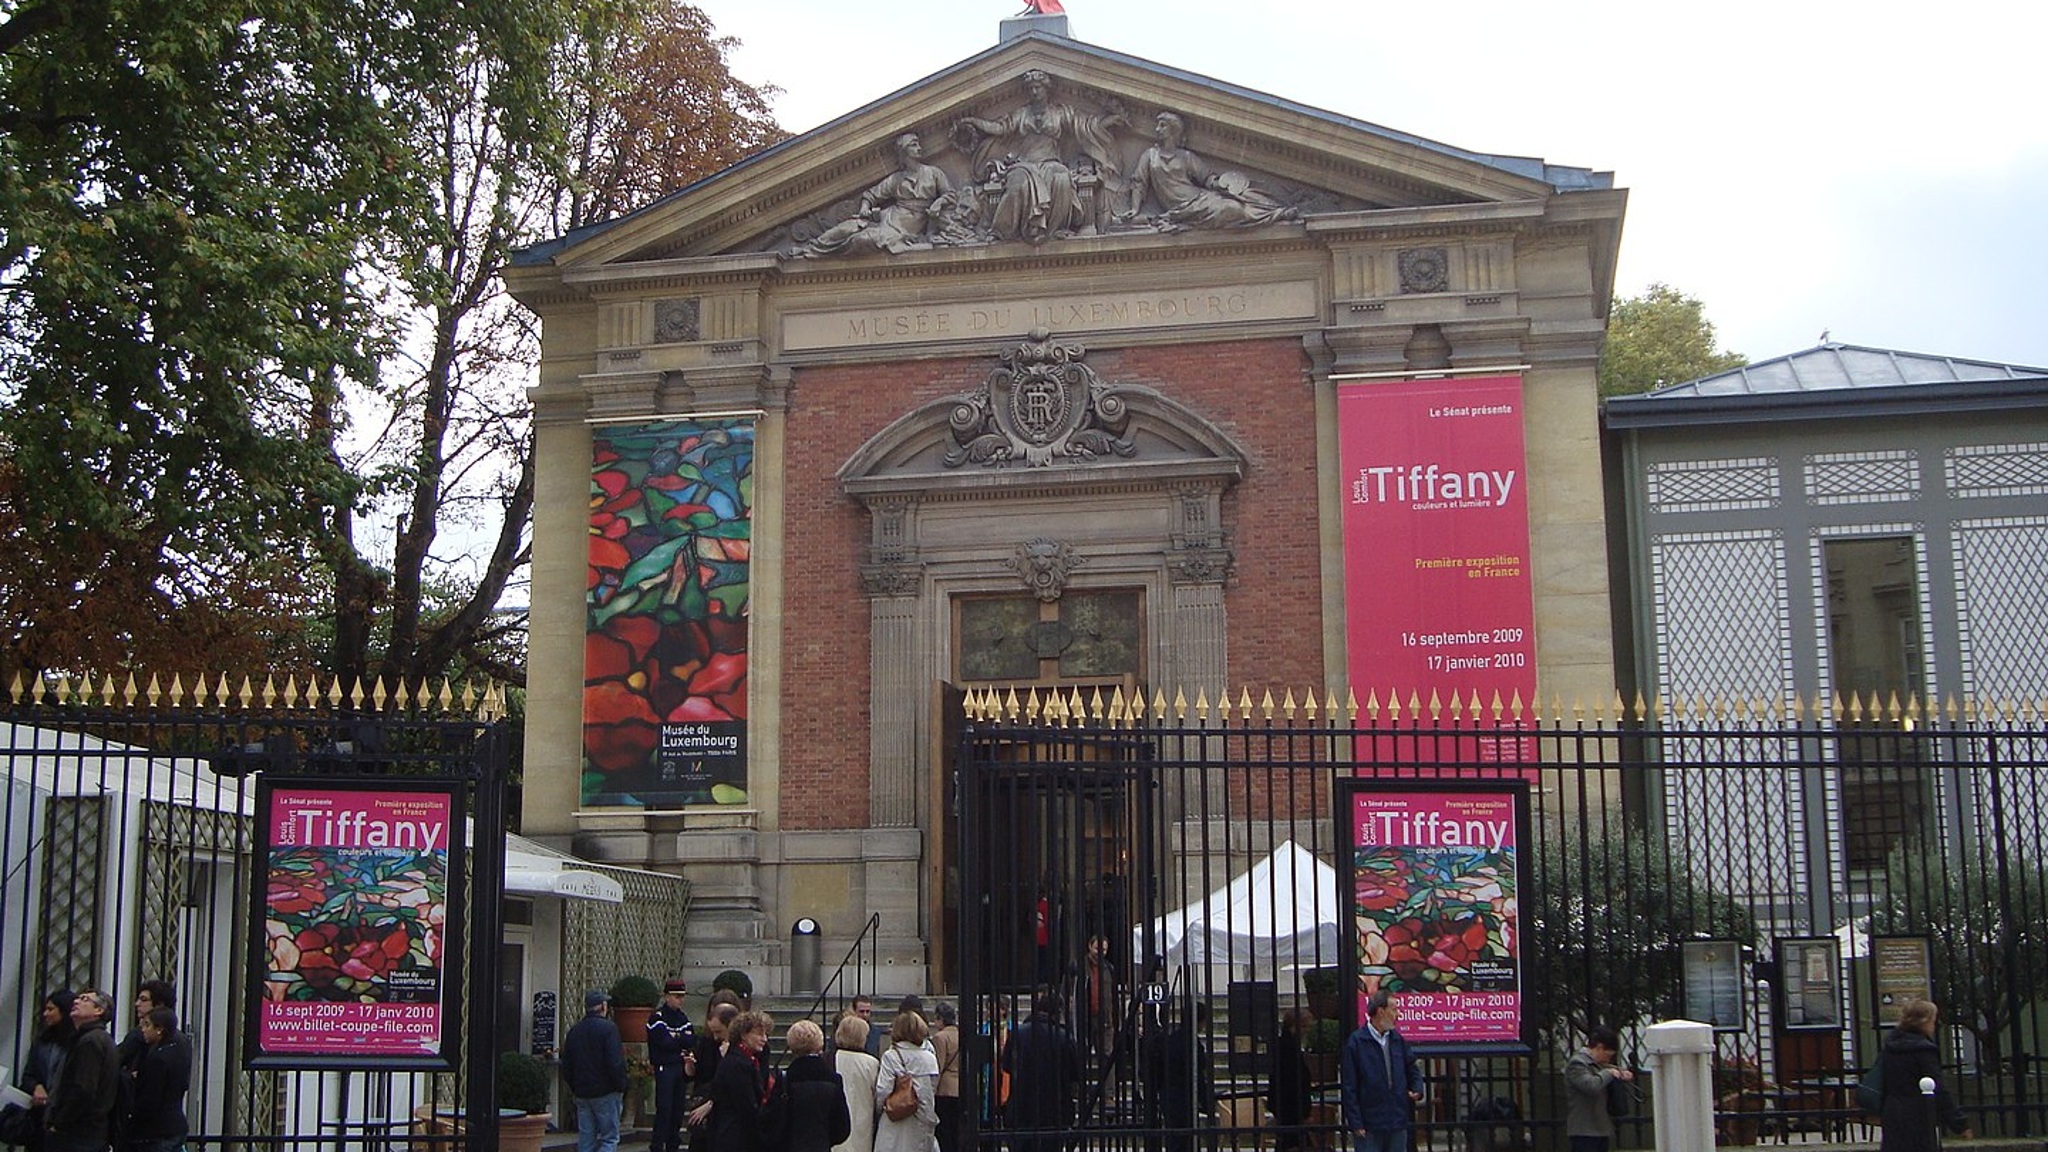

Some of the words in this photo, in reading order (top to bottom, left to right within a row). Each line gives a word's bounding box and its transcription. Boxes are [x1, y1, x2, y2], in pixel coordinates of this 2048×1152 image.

[847, 312, 951, 340] MUSÉE
[967, 309, 1012, 332] DU
[1033, 293, 1249, 327] LUXEMBOURG
[1429, 407, 1441, 418] Le
[1443, 405, 1470, 417] Sénat
[1471, 404, 1512, 417] présente
[1368, 464, 1515, 506] Tiffany
[1412, 501, 1448, 511] couleurs
[1449, 500, 1458, 509] et
[1459, 499, 1491, 509] lumière
[1415, 558, 1463, 569] Première
[1466, 555, 1520, 567] exposition
[1468, 570, 1481, 578] en
[1484, 567, 1520, 577] France
[1401, 632, 1416, 647] 16
[1420, 629, 1490, 648] septembre
[1492, 628, 1523, 643] 2009
[1427, 656, 1442, 671] 17
[1445, 655, 1492, 673] janvier
[1494, 653, 1525, 668] 2010
[662, 724, 695, 735] Musée
[697, 724, 710, 734] du
[662, 734, 738, 748] Luxembourg
[375, 800, 406, 809] Première
[407, 802, 443, 811] exposition
[278, 821, 288, 845] Louis
[287, 809, 296, 845] Comfort
[297, 810, 442, 857] Tiffany
[1376, 811, 1509, 854] Tiffany
[338, 848, 373, 857] couleurs
[390, 977, 436, 986] Luxembourg
[1147, 985, 1163, 1001] 19
[1407, 996, 1434, 1007] 2009
[1446, 996, 1458, 1007] 17
[1461, 996, 1486, 1009] janv
[1488, 995, 1514, 1006] 2010
[269, 1004, 283, 1017] 16
[286, 1006, 313, 1019] sept
[316, 1005, 345, 1017] 2009
[359, 1006, 373, 1018] 17
[376, 1006, 402, 1020] janv
[405, 1006, 435, 1019] 2010
[268, 1019, 434, 1034] www.billet-coupe-file.com
